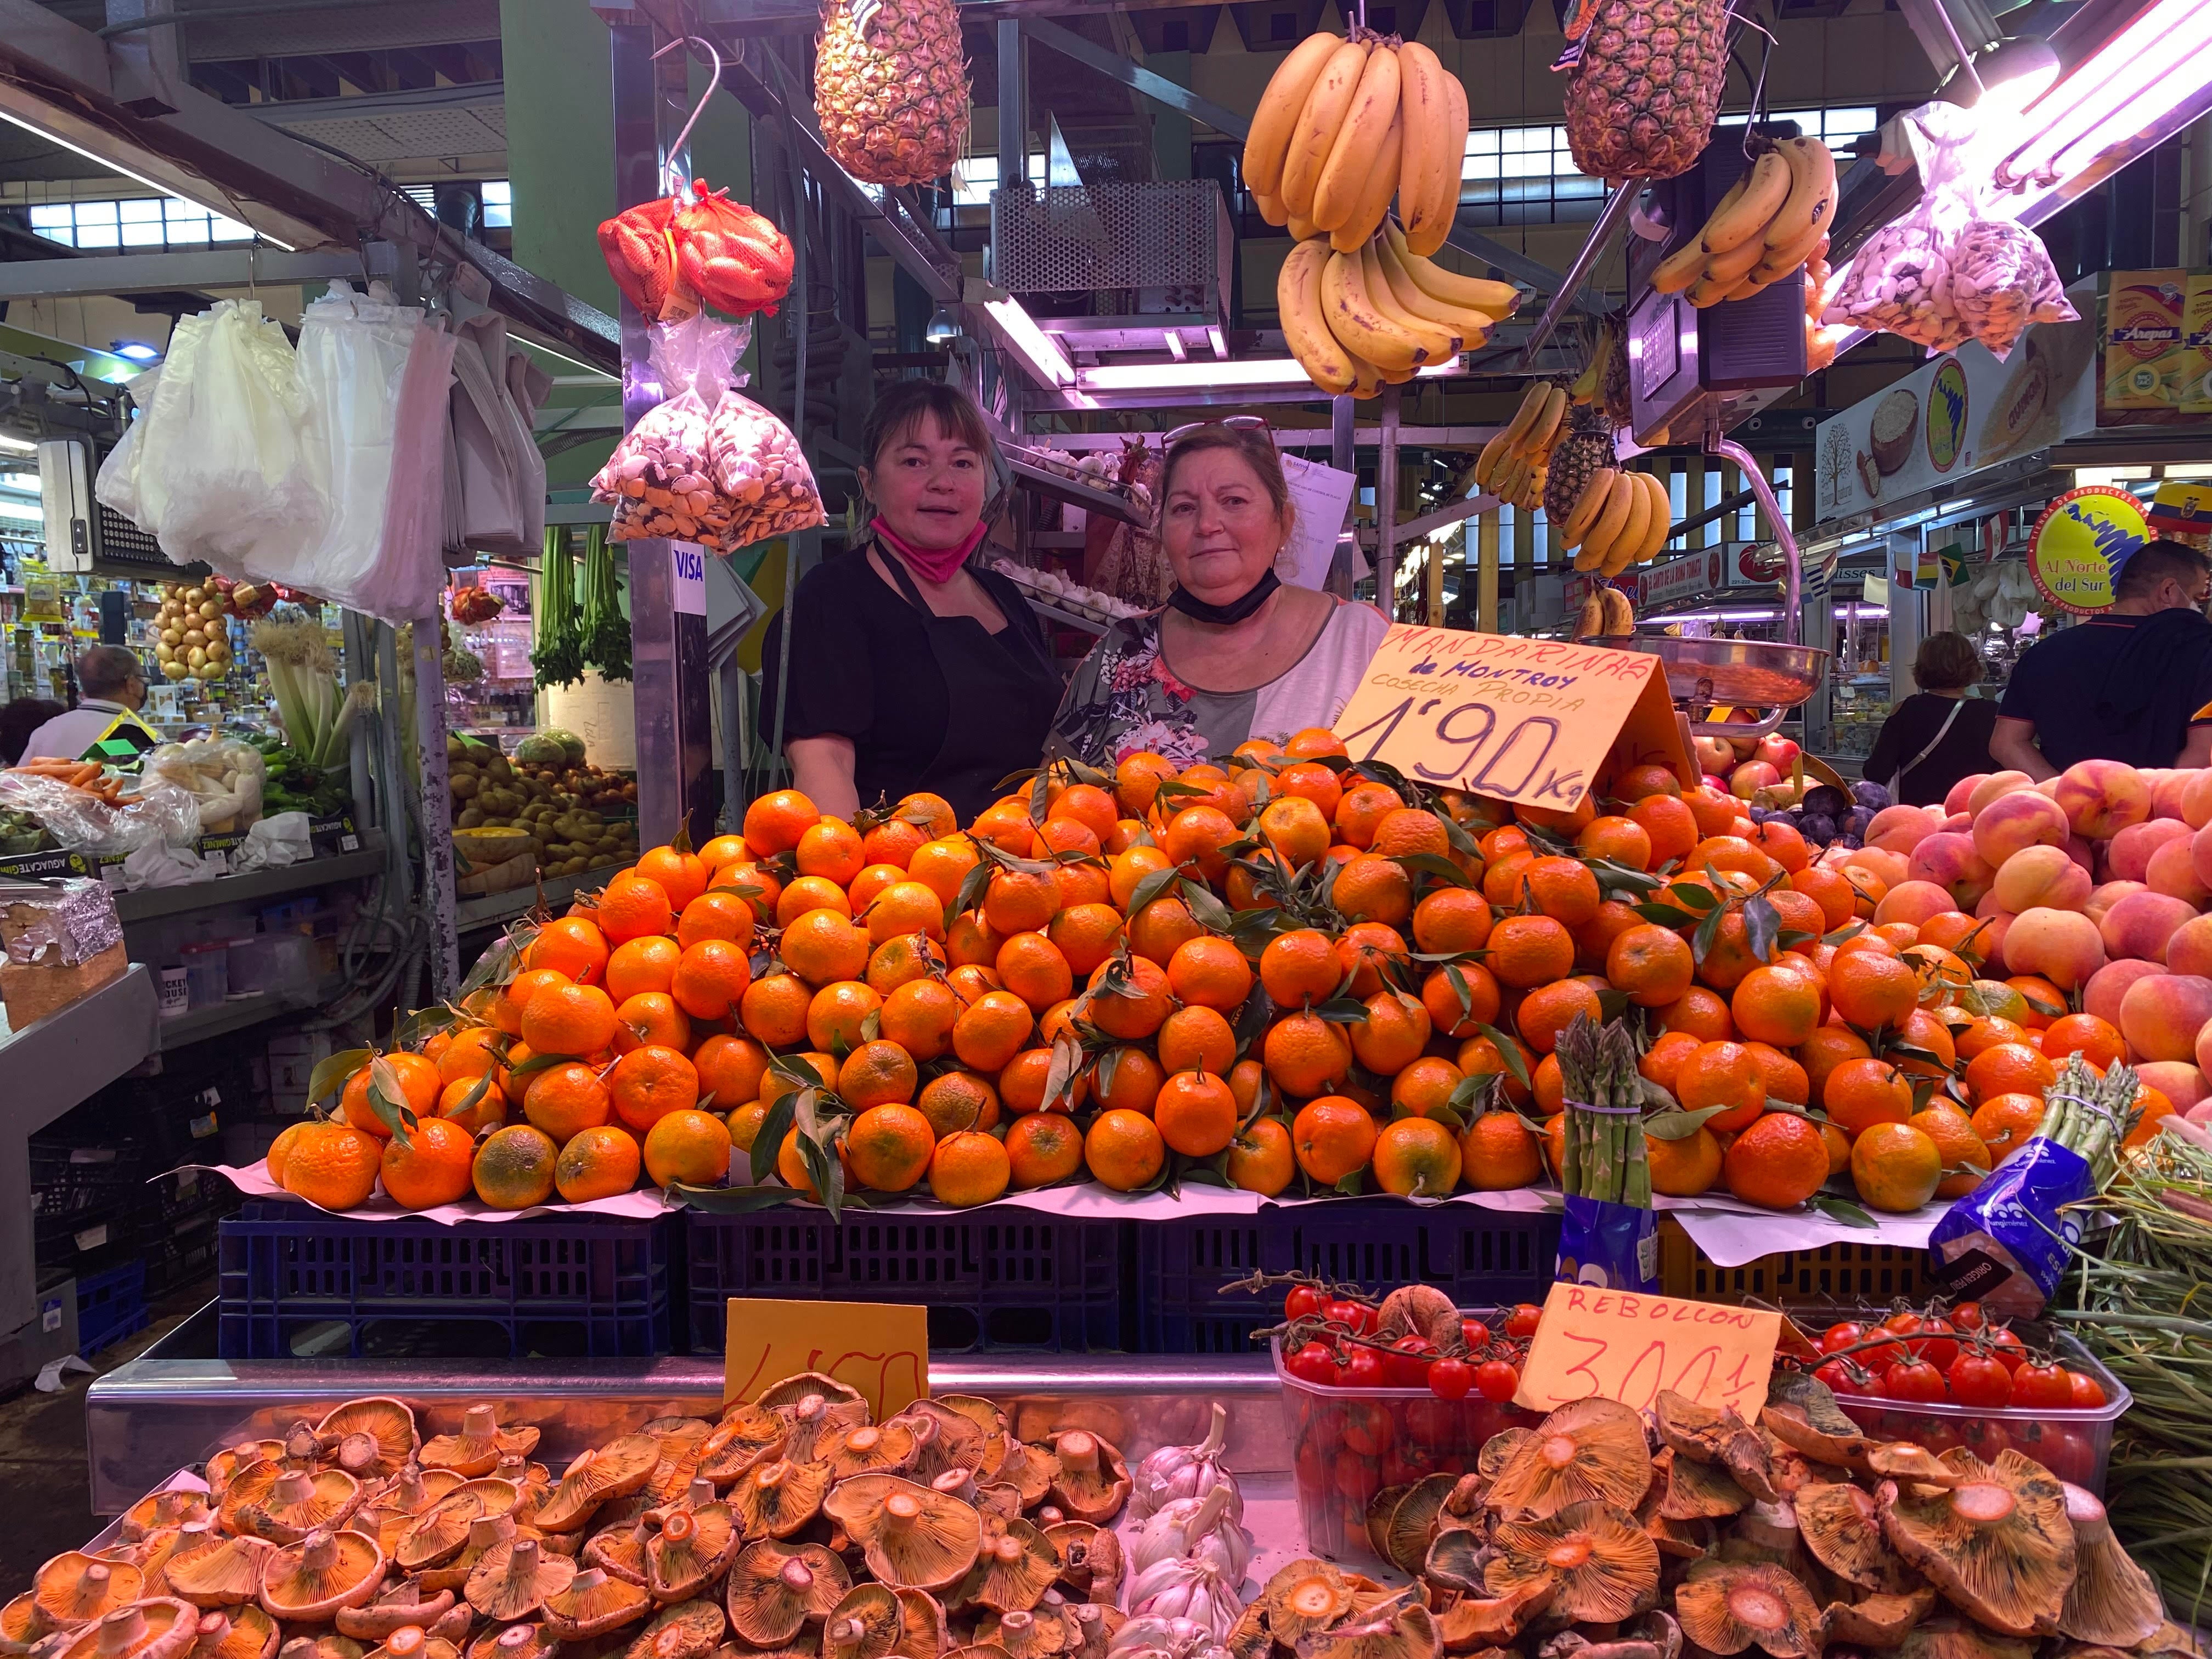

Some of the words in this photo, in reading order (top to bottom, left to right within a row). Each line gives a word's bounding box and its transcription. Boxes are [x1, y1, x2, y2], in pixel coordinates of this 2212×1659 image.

[2123, 327, 2173, 341] Arepas
[2031, 508, 2055, 540] TIENDA
[2058, 496, 2068, 506] DE
[2074, 487, 2132, 503] PRODUCTOS
[674, 549, 703, 582] VISA
[2041, 560, 2059, 575] Al
[2063, 558, 2106, 574] Norte
[2032, 573, 2049, 595] VENTA
[2049, 595, 2059, 605] DE
[2059, 602, 2105, 615] PRODUCTOS
[2055, 577, 2076, 592] del
[2081, 578, 2106, 591] Sur
[1379, 628, 1653, 681] MANDARINAS
[1408, 654, 1436, 674] de
[1439, 659, 1578, 690] MONTROY
[1371, 673, 1459, 696] COSECHA
[1471, 680, 1585, 711] PROPIA
[1532, 767, 1585, 807] Kg
[1962, 1262, 1993, 1284] ORIGEN
[1567, 1288, 1755, 1329] REBOLLON
